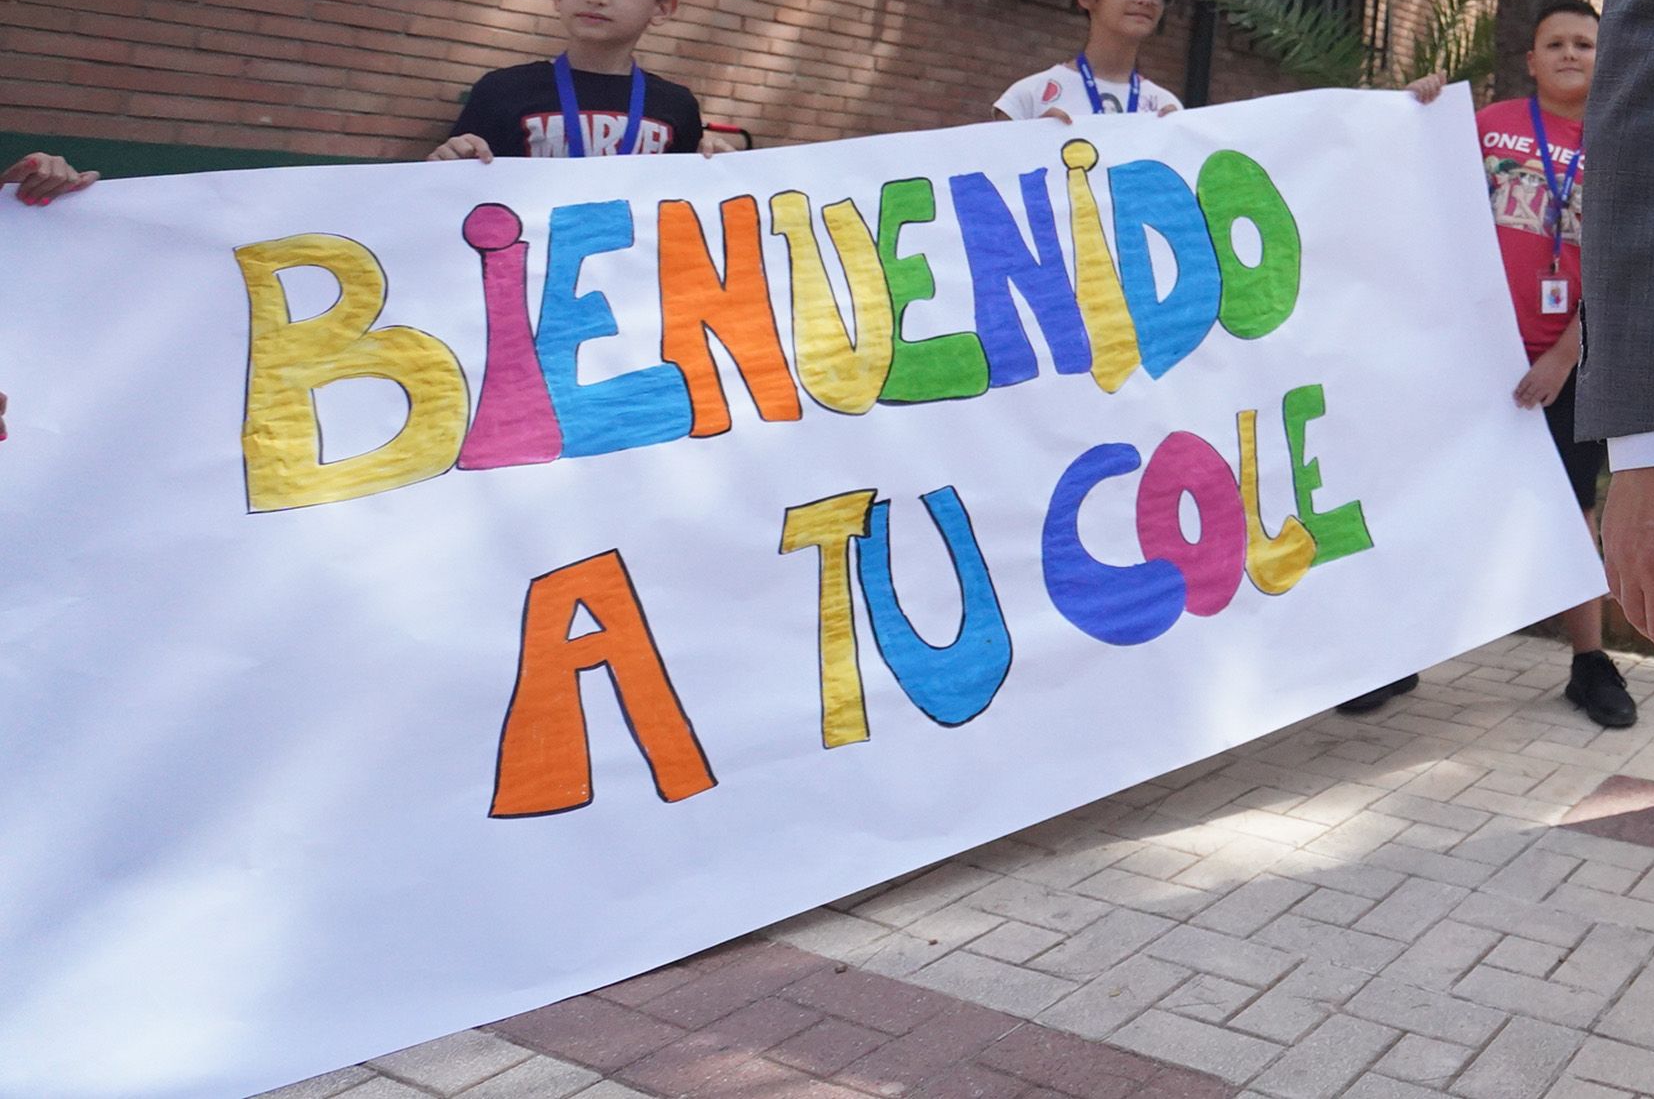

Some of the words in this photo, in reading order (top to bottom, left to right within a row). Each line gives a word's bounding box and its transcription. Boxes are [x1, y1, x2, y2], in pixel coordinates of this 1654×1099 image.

[1483, 131, 1535, 154] ONE
[487, 548, 718, 819] A
[778, 485, 1013, 749] TU
[1041, 383, 1375, 647] COLE
